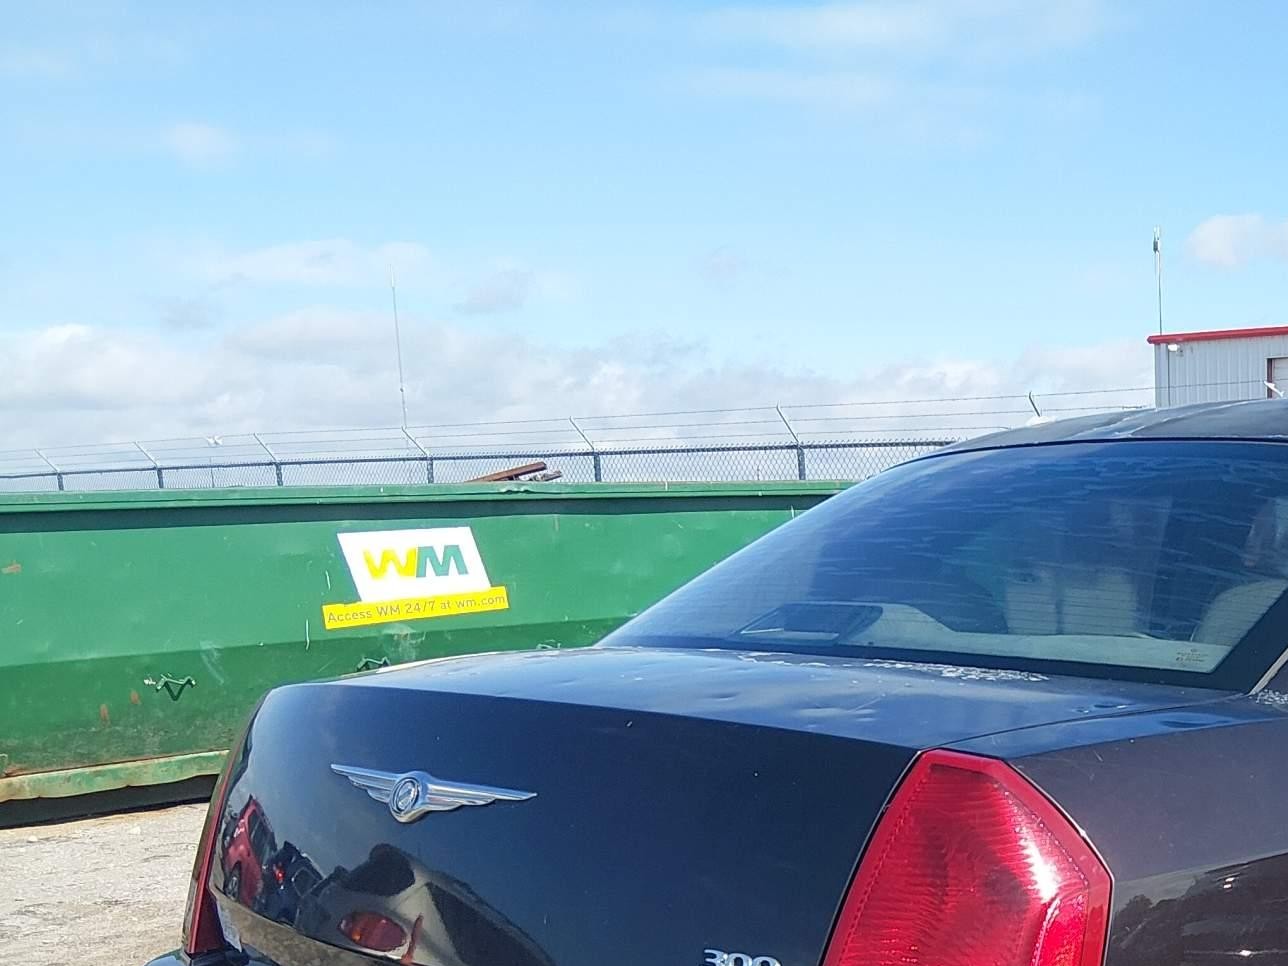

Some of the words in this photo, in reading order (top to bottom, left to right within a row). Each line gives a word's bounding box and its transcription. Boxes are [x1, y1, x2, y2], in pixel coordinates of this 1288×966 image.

[363, 544, 469, 580] WM
[327, 609, 373, 623] Access
[376, 604, 401, 617] WM
[405, 600, 437, 614] 24/7
[440, 600, 452, 611] at
[456, 594, 506, 609] wm.com
